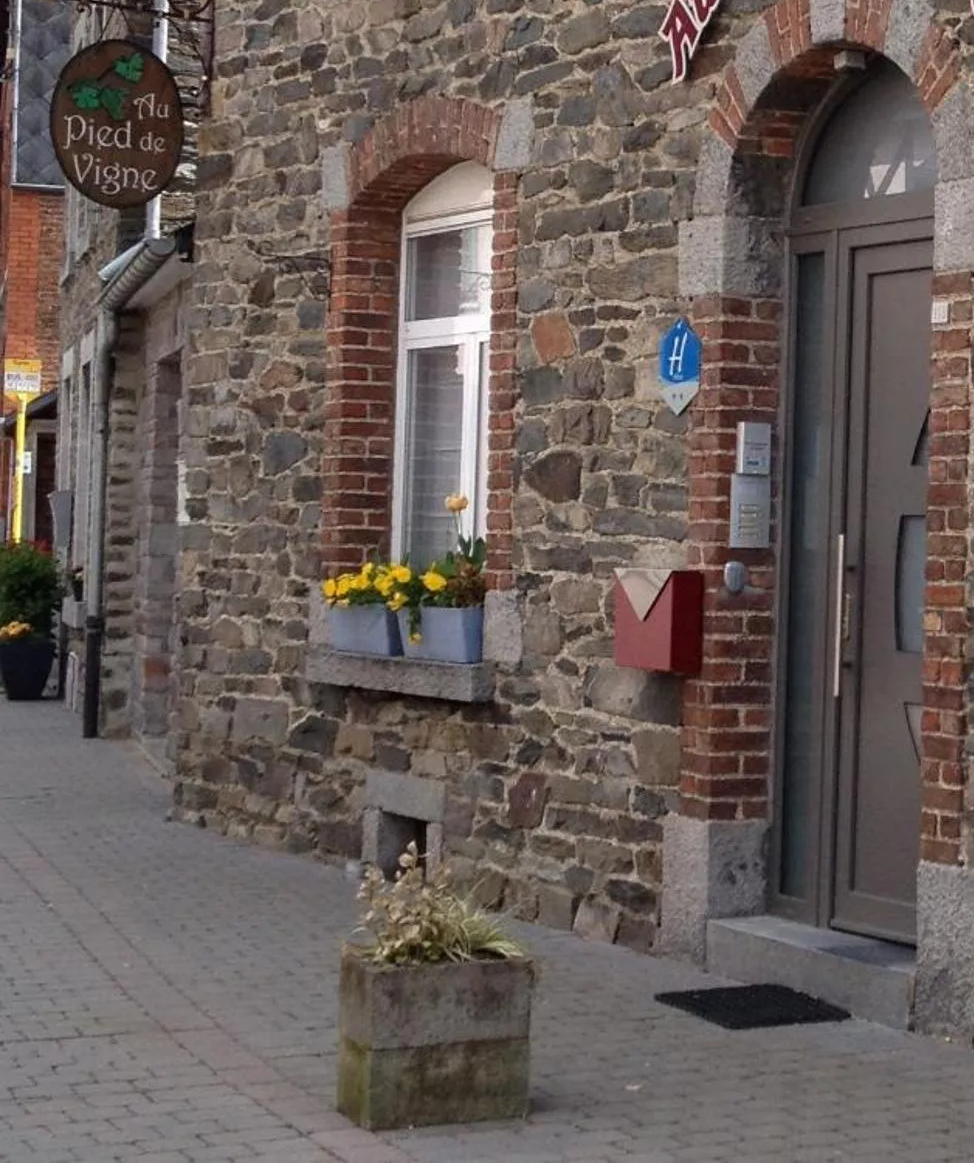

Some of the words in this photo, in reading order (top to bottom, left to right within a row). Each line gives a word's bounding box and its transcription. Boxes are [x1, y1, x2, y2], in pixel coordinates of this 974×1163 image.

[133, 93, 170, 120] Au
[63, 114, 132, 149] Pied
[139, 132, 166, 153] de
[72, 153, 159, 195] Vigne
[668, 332, 688, 376] H
